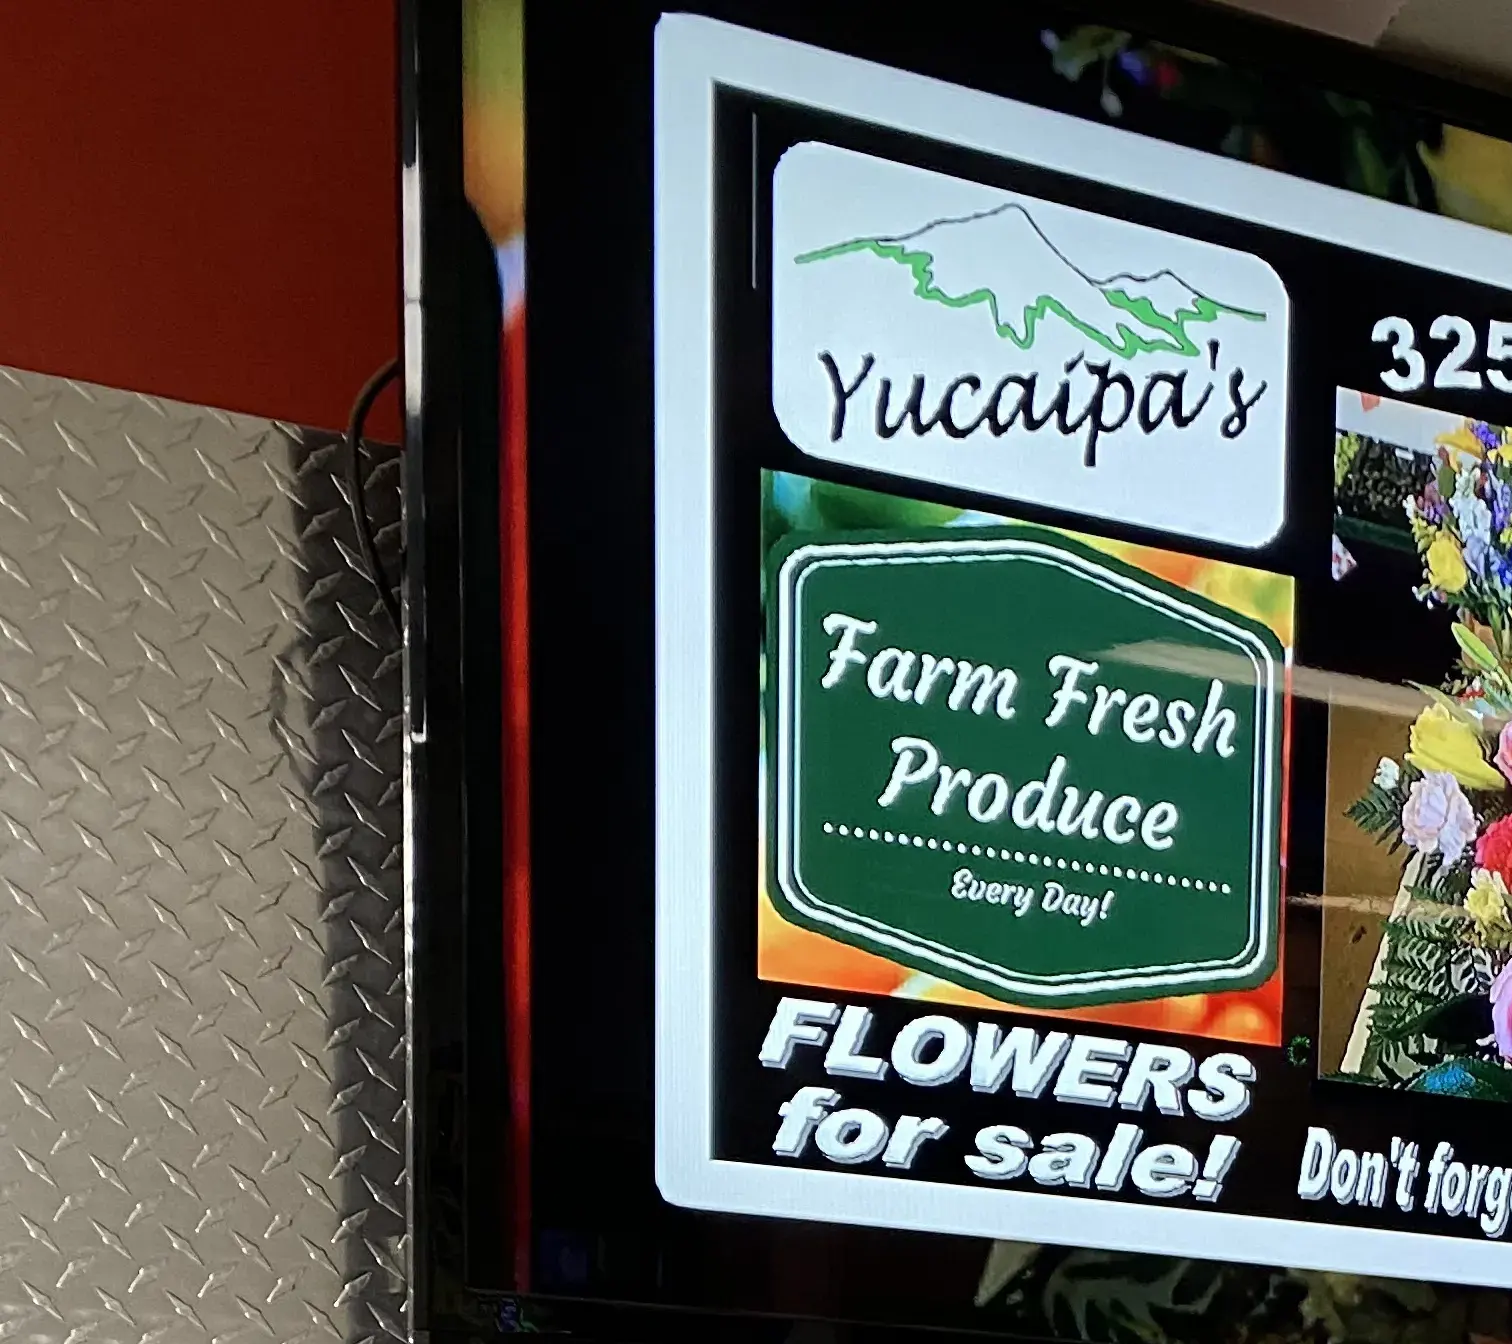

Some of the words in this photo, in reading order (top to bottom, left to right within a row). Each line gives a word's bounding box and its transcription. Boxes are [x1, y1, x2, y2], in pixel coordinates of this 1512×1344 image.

[818, 338, 1268, 467] Yucaipa's
[820, 612, 1017, 720] Farm
[1045, 654, 1236, 758] Fresh
[877, 735, 1178, 850] Produce
[951, 868, 1034, 918] Every
[1041, 881, 1115, 927] Day!
[758, 996, 1257, 1122] FLOWERS
[772, 1086, 949, 1169] for
[964, 1122, 1241, 1202] sale!
[1298, 1127, 1420, 1212] Don't
